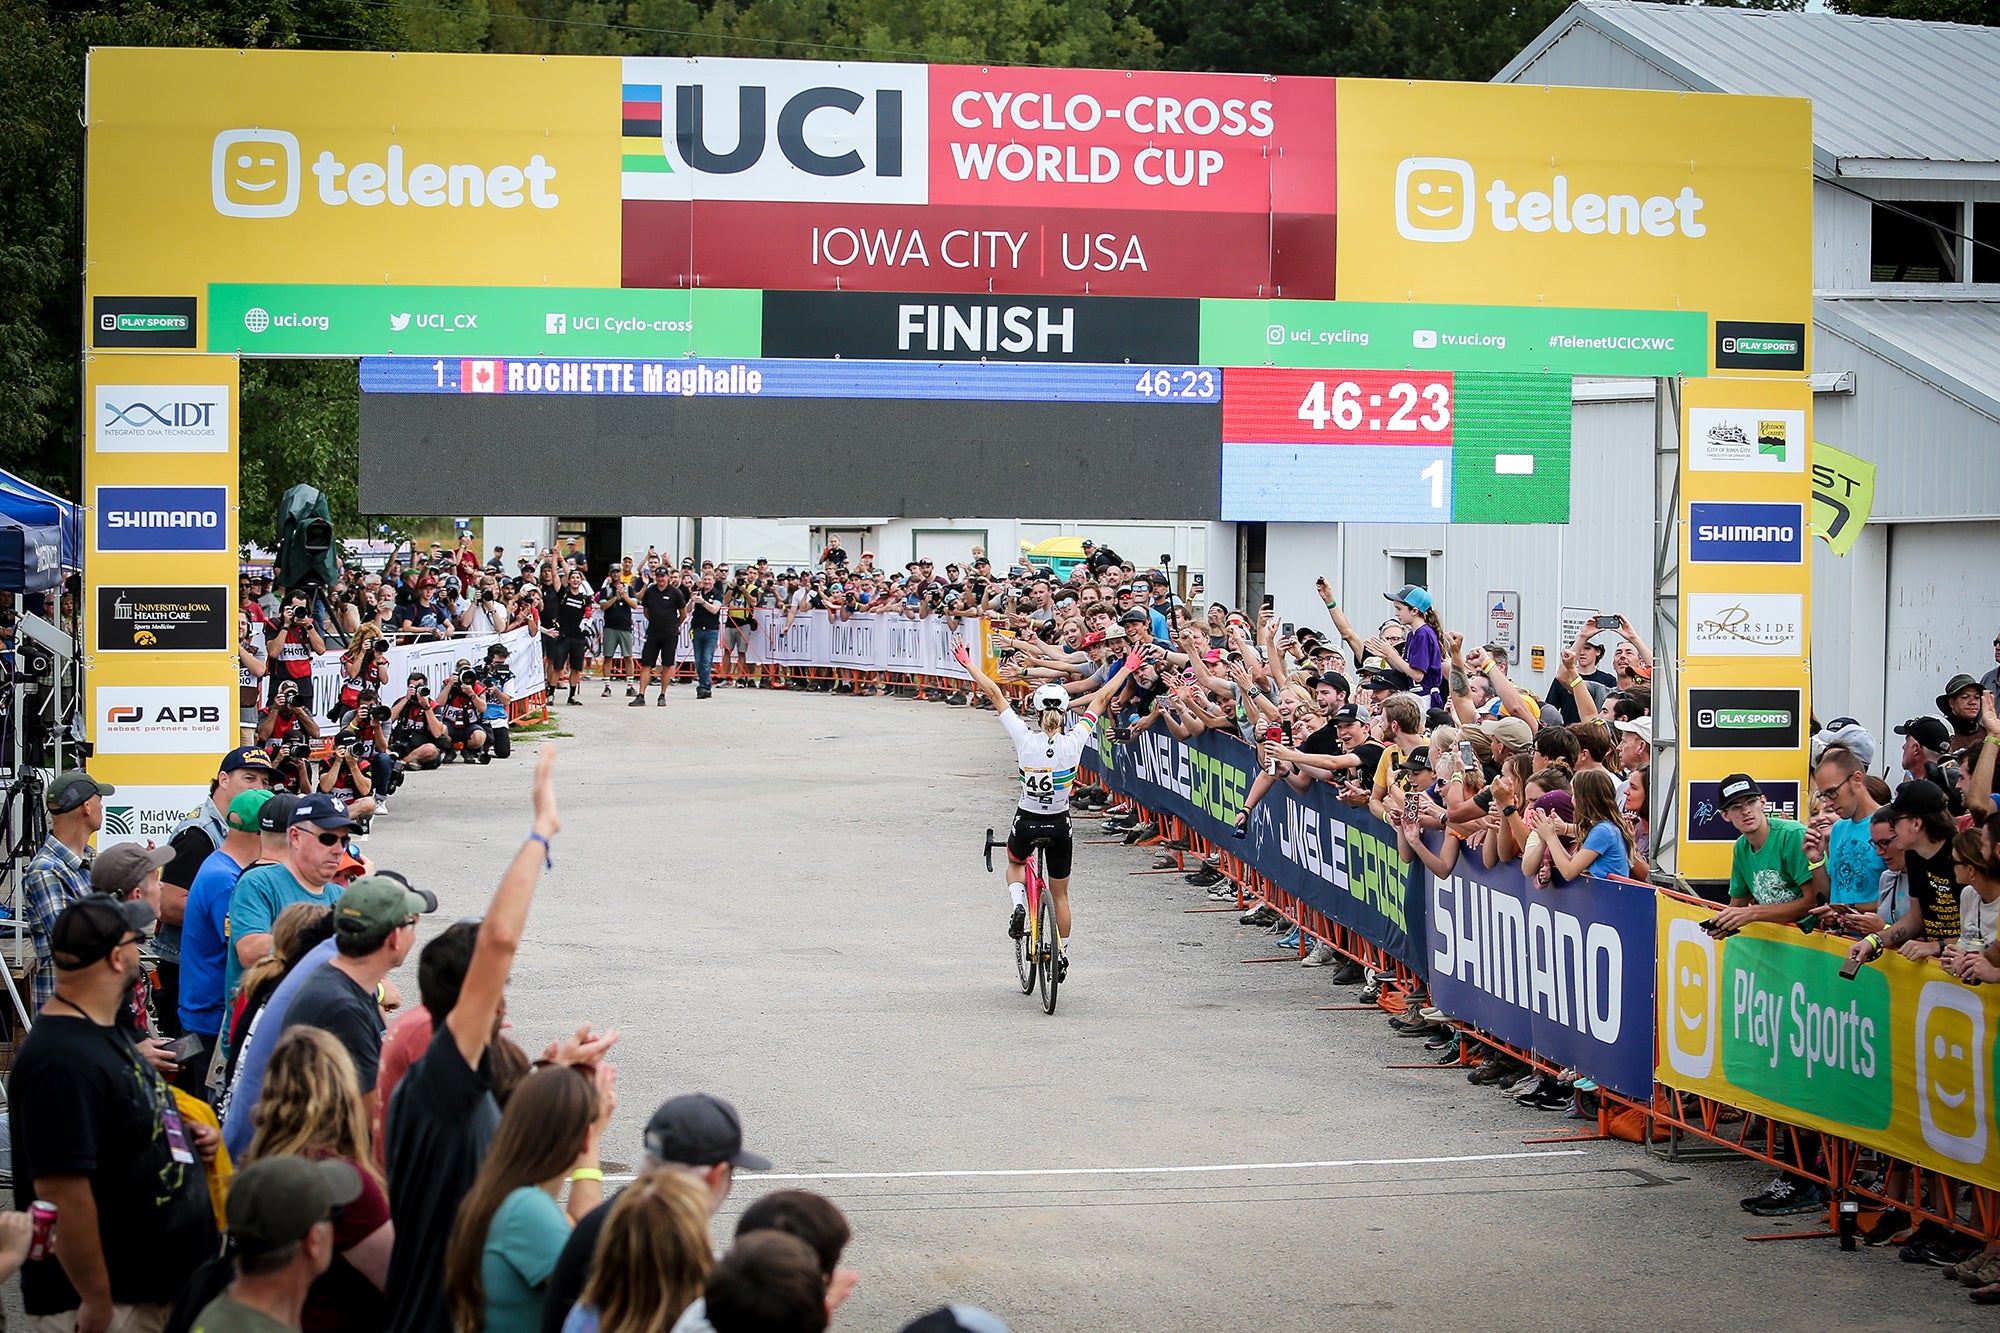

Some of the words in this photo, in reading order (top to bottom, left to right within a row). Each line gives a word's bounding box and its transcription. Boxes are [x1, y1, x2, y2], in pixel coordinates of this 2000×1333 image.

[950, 89, 1275, 138] CYCLO-CROSS
[676, 84, 902, 177] UCI
[950, 143, 1121, 184] WORLD
[1133, 147, 1225, 187] CUP
[311, 145, 560, 210] telenet
[1485, 175, 1707, 239] telenet
[811, 226, 929, 268] IOWA
[939, 229, 1028, 269] CITY
[1061, 233, 1149, 272] USA
[120, 317, 146, 327] PLAY
[146, 318, 187, 328] SPORTS
[273, 312, 330, 333] uci.org
[416, 313, 478, 333] UCI_CX
[572, 315, 600, 332] UCI
[604, 317, 693, 335] Cyclo-cross
[898, 304, 1075, 353] FINISH
[1290, 327, 1370, 348] uci_cycling
[1440, 330, 1506, 351] tv.uci.org
[1548, 333, 1675, 352] #TelenetUCICXWC
[1739, 341, 1766, 352] PLAY
[1766, 342, 1796, 353] SPORTS
[432, 359, 457, 388] 1.
[508, 362, 635, 393] ROCHETTE
[642, 363, 763, 396] Maghalie
[1135, 370, 1214, 398] 46:23
[174, 402, 216, 427] IDT
[1297, 380, 1450, 431] 46:23
[1759, 422, 1785, 431] Johnson
[1761, 429, 1785, 438] County
[1420, 459, 1444, 509] 1
[107, 511, 218, 528] SHIMANO
[1698, 525, 1794, 543] SHIMANO
[791, 624, 810, 653] CITY
[1696, 623, 1795, 633] RIVERSIDE
[832, 625, 854, 656] IOWA
[856, 627, 873, 657] CITY
[312, 675, 341, 716] OWA
[155, 707, 220, 723] APB
[1720, 714, 1747, 724] PLAY
[1747, 714, 1789, 724] SPORTS
[144, 726, 188, 734] partners
[1026, 775, 1053, 792] 46
[140, 810, 190, 822] MidWe
[140, 823, 173, 835] Bank
[1433, 874, 1623, 1044] SHIMANO
[1733, 968, 1784, 1068] Play
[1789, 981, 1876, 1079] Sports
